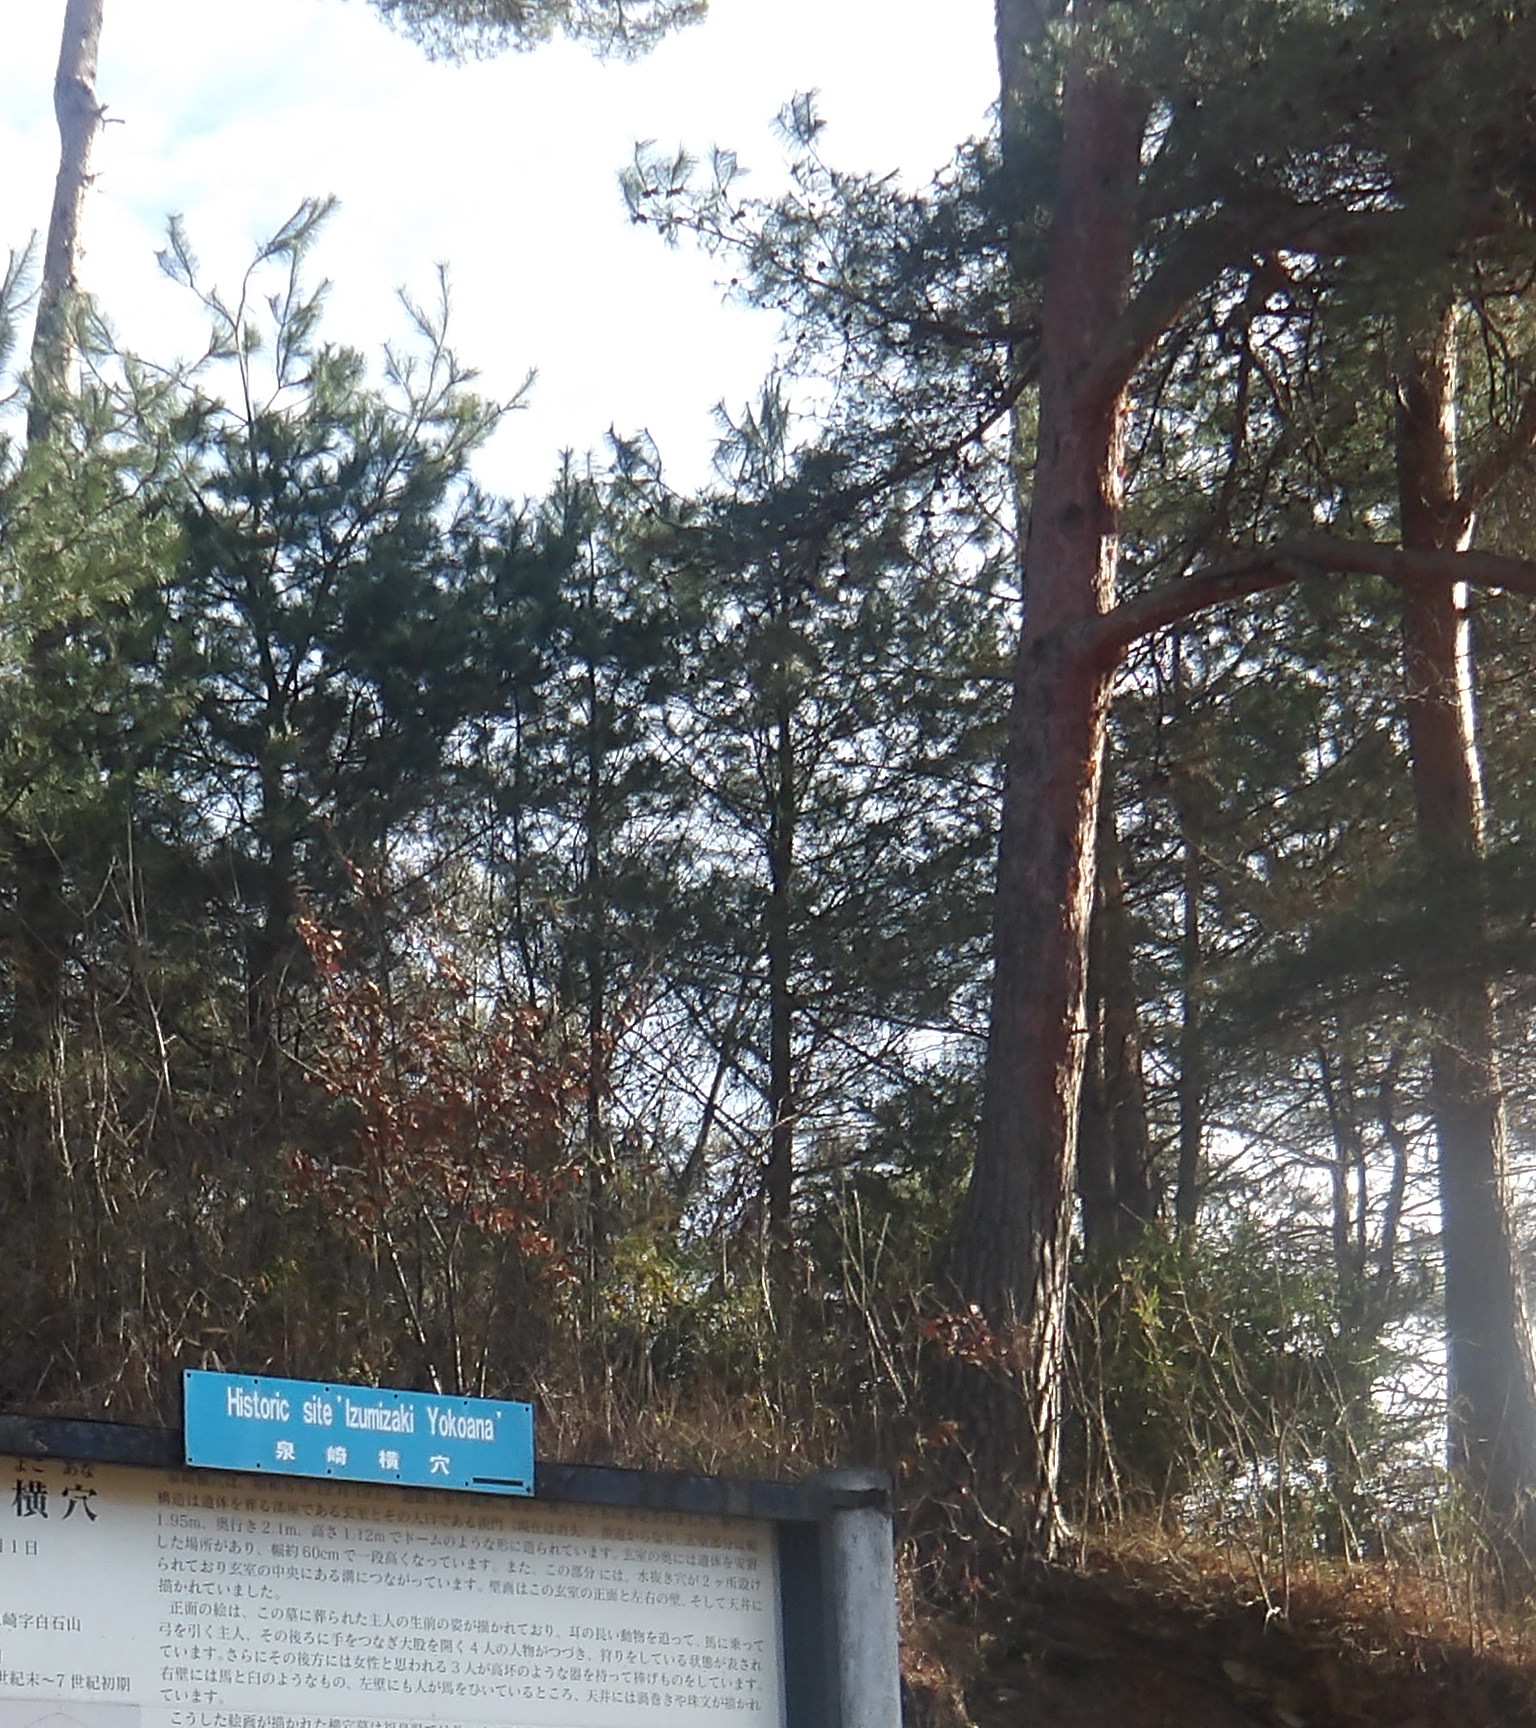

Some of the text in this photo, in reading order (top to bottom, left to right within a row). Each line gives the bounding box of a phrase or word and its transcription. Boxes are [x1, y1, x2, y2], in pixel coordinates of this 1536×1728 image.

[227, 1387, 290, 1421] Historic
[303, 1396, 332, 1426] site
[159, 1578, 282, 1600] 描かれていました。
[160, 1689, 225, 1706] ています。
